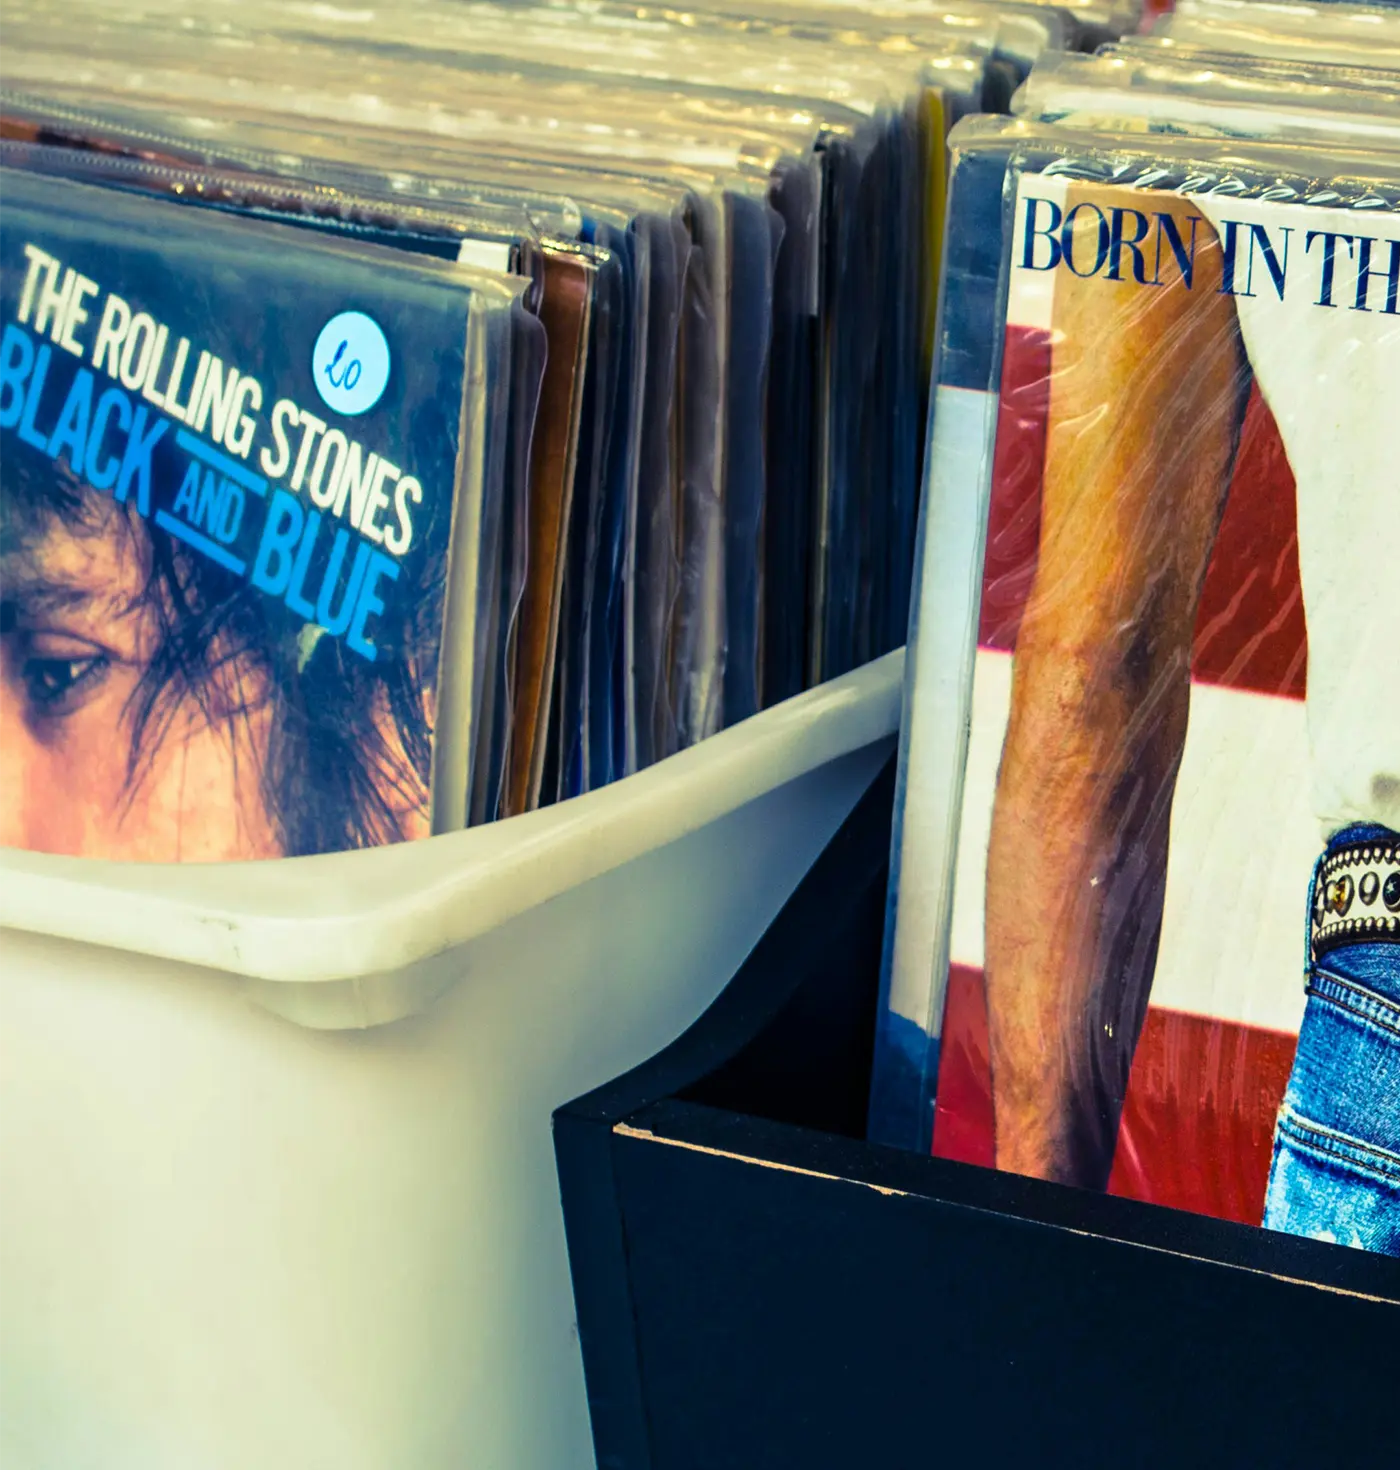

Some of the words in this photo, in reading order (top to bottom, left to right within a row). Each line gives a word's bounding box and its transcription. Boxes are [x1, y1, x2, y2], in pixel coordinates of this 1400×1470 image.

[17, 243, 99, 356] THE
[92, 293, 262, 460] ROLLING
[260, 399, 424, 556] STONES
[1016, 196, 1203, 292] BORN
[1216, 219, 1296, 303] IN
[0, 323, 171, 519] BLACK
[172, 461, 247, 546] AND
[250, 489, 400, 663] BLUE
